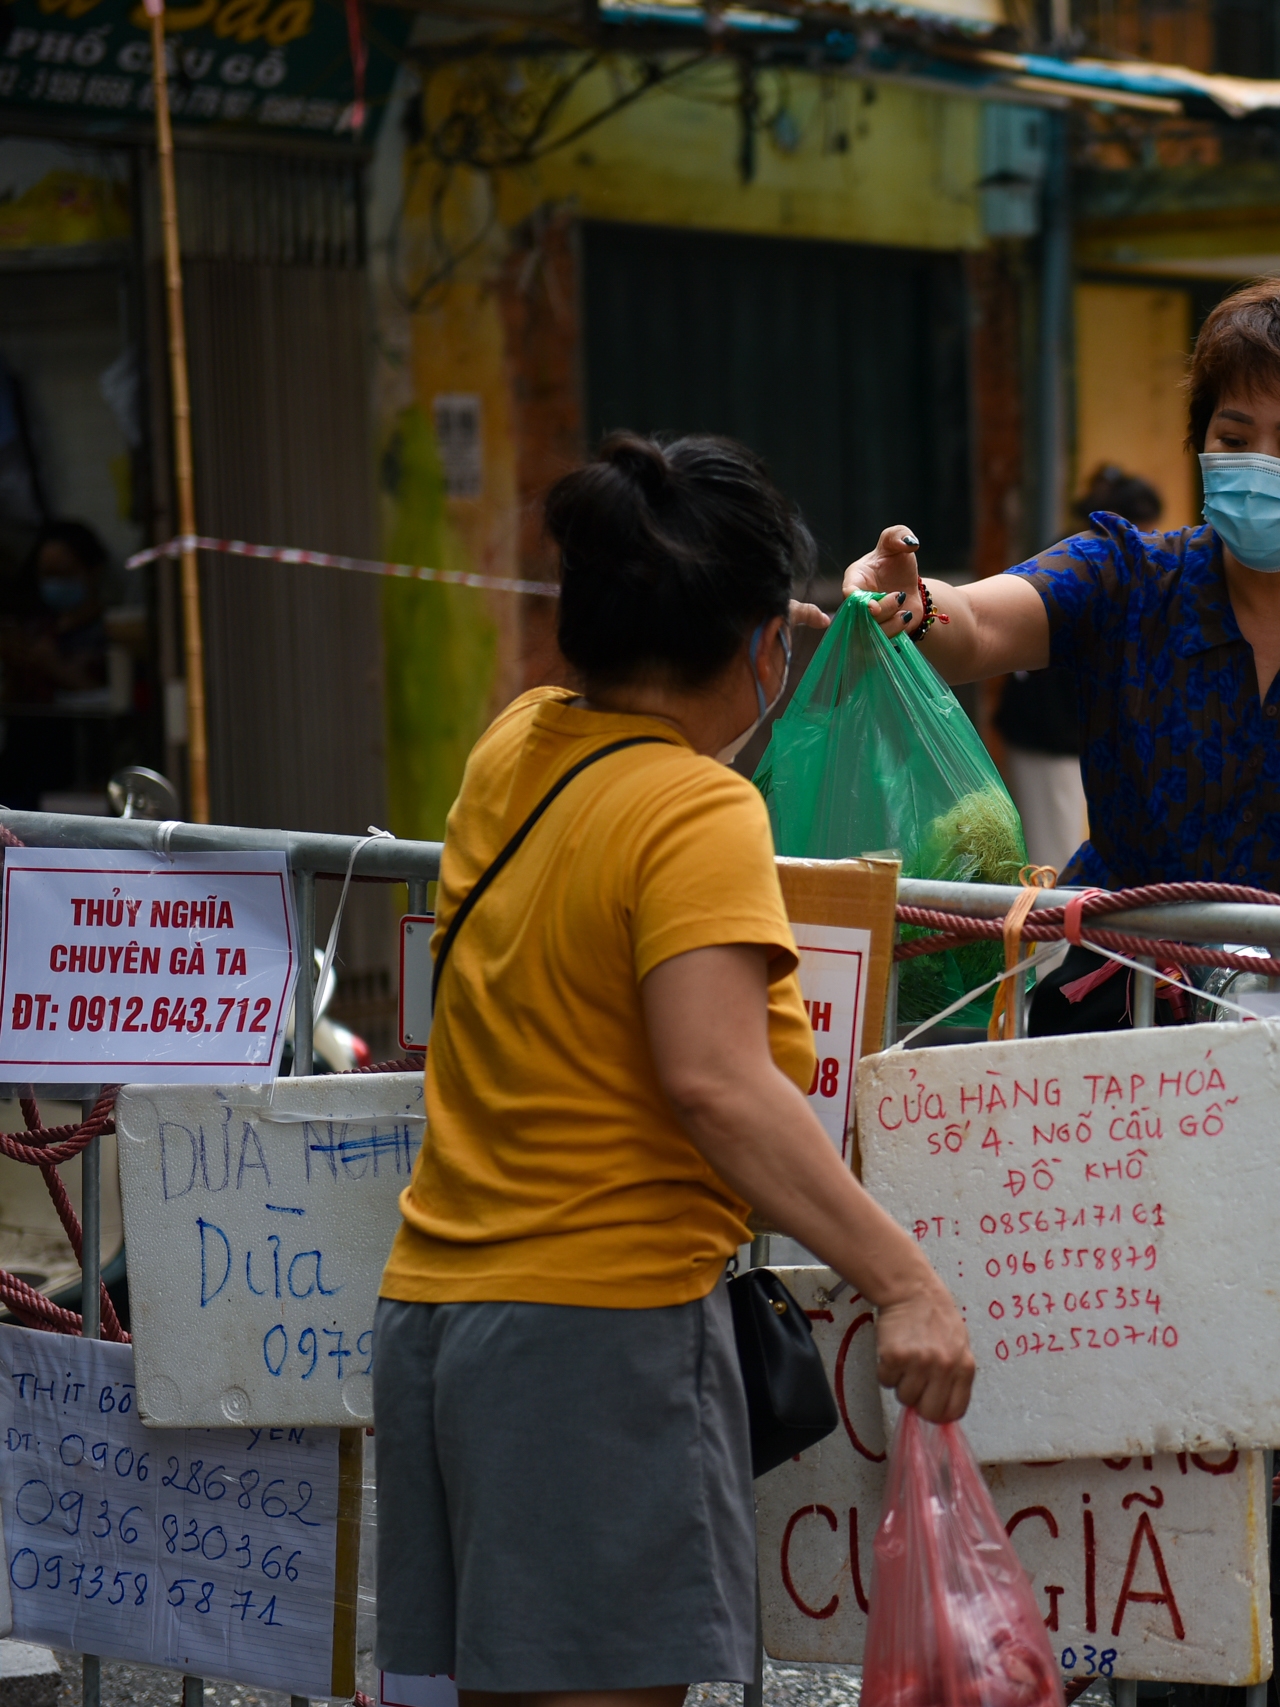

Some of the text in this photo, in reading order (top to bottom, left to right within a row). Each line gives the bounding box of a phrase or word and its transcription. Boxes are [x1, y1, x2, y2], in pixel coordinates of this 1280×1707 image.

[71, 887, 234, 929] THỦY NGHĨA
[50, 941, 247, 976] CHUYÊN GÀ TA
[12, 993, 272, 1033] ĐT: 0912.643.712
[960, 1070, 1061, 1115] HÀNG
[1083, 1073, 1145, 1110] TẠP
[1033, 1111, 1091, 1145] NGÕ
